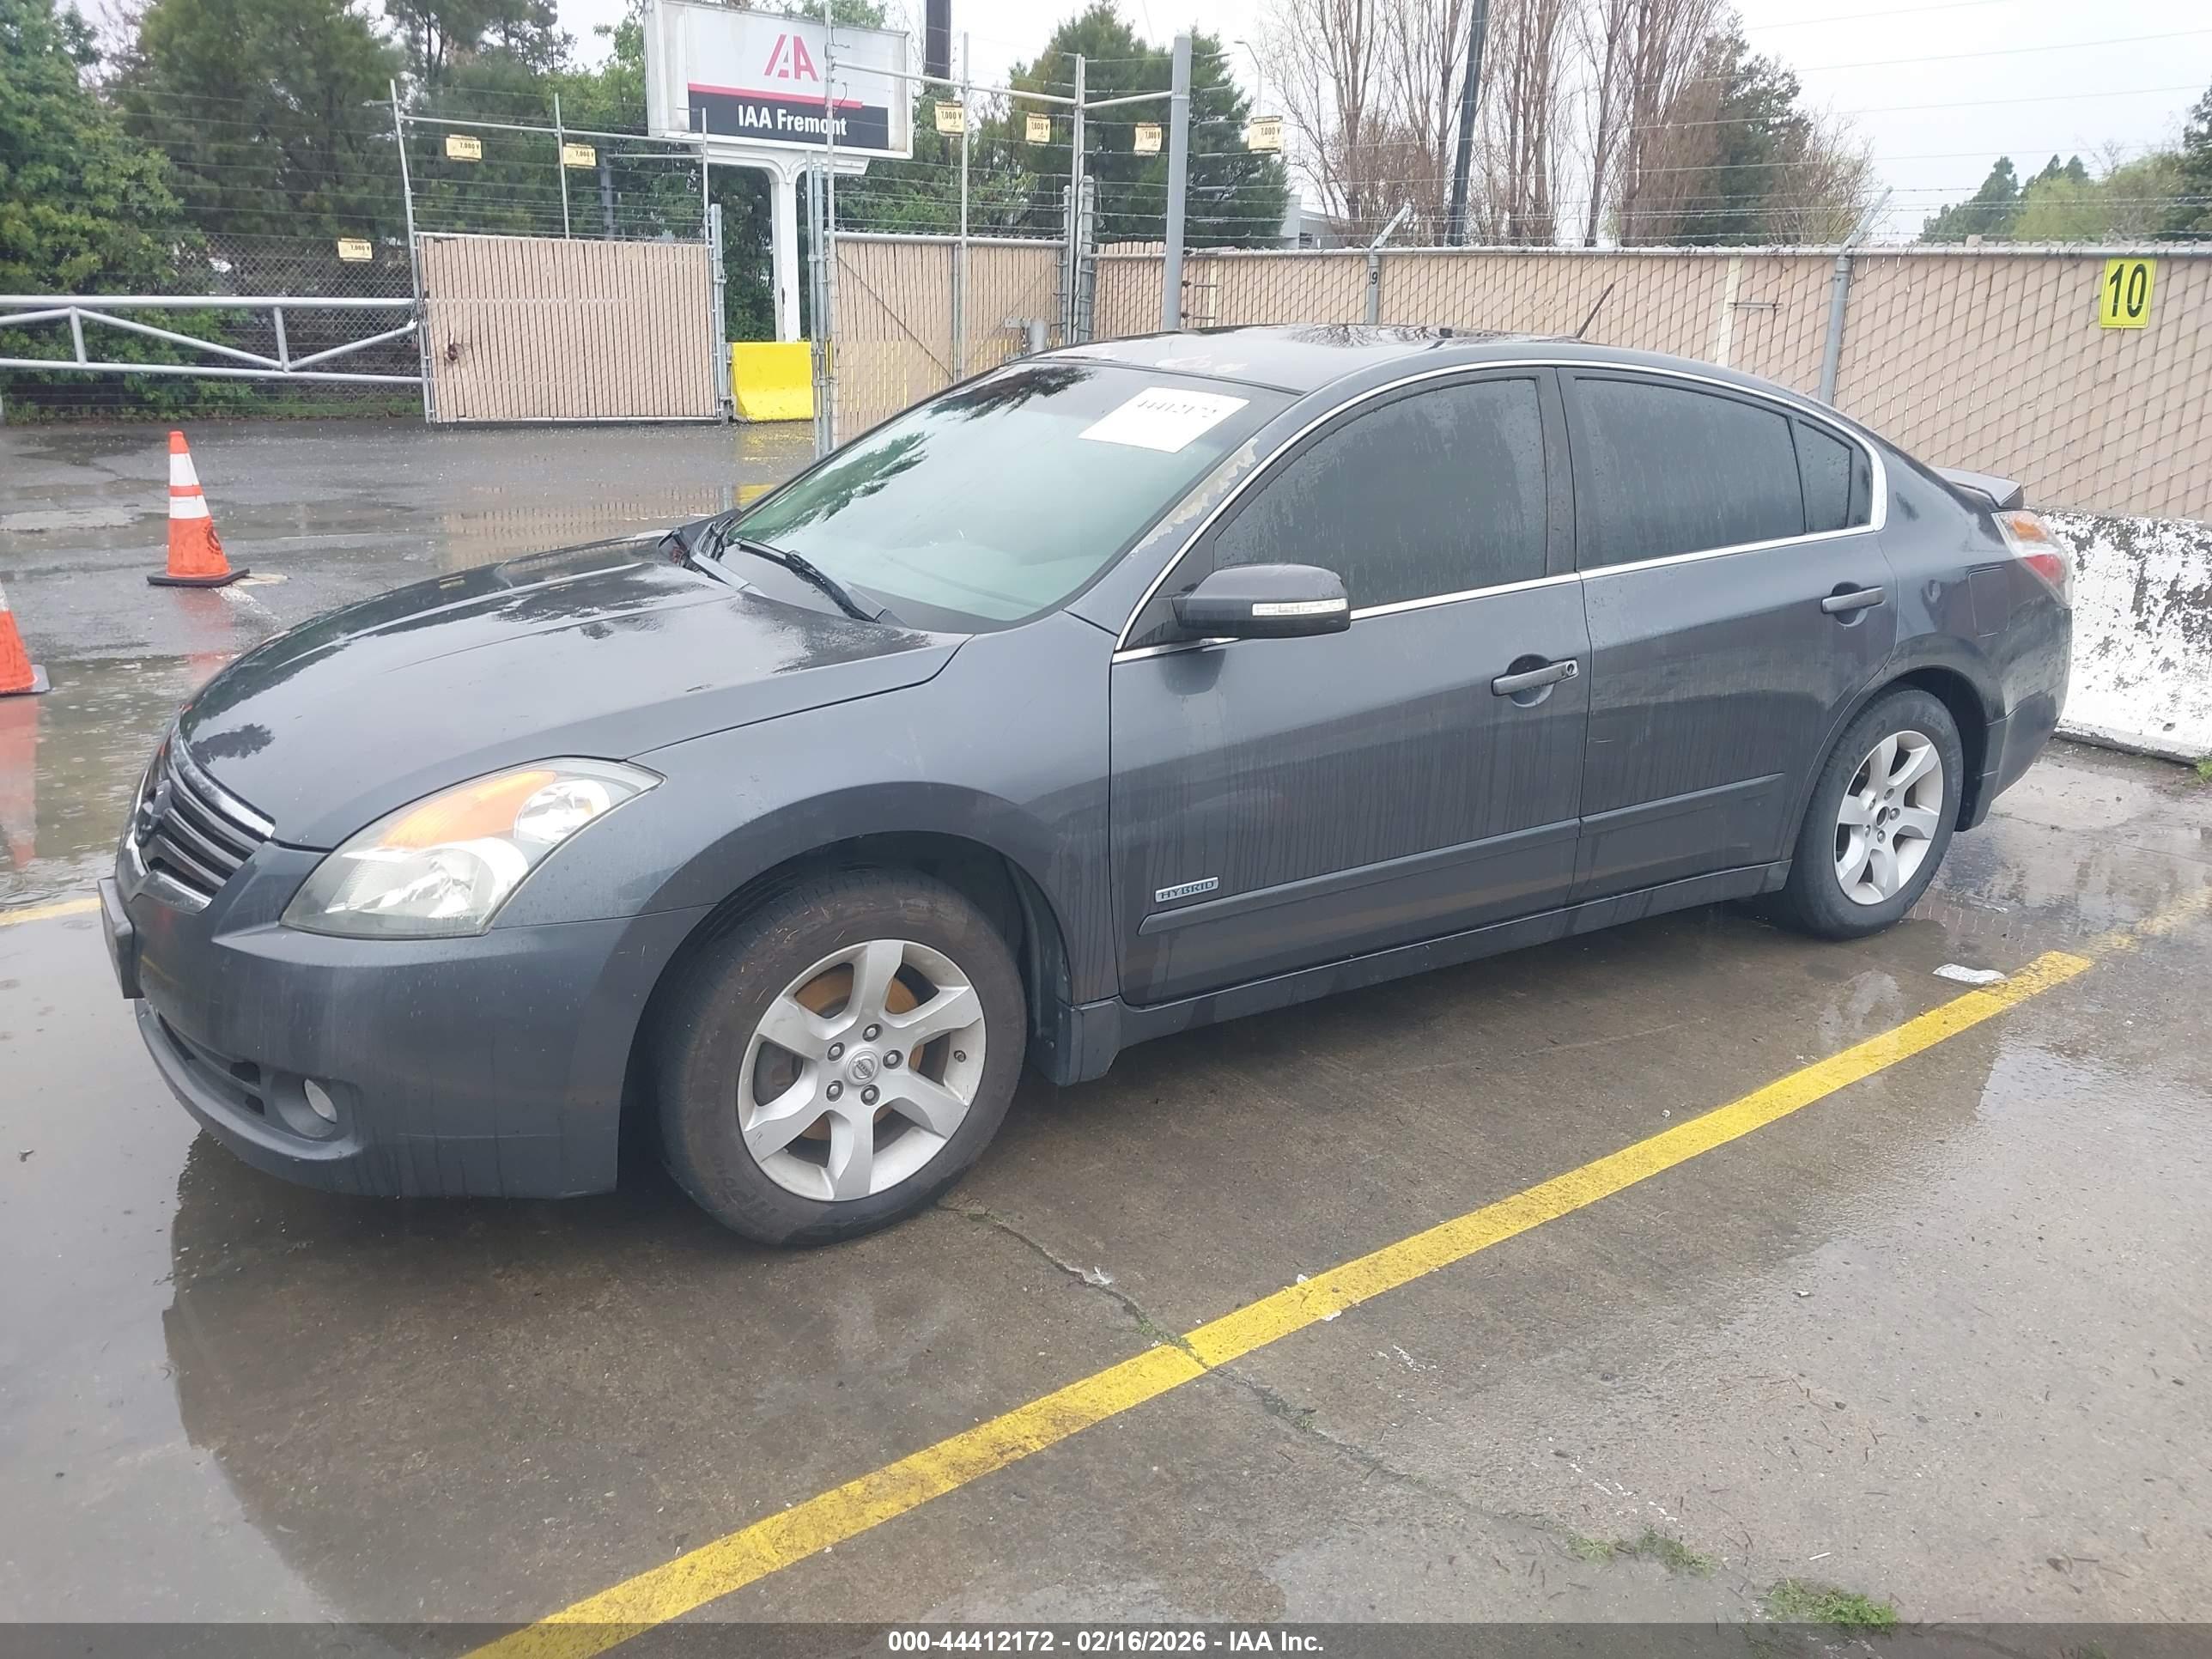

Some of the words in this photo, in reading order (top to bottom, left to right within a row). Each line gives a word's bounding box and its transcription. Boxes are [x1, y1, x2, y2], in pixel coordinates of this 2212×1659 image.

[738, 104, 773, 129] IAA
[777, 108, 848, 136] Fremont
[2109, 264, 2147, 318] 10
[1161, 881, 1214, 900] HYBRID
